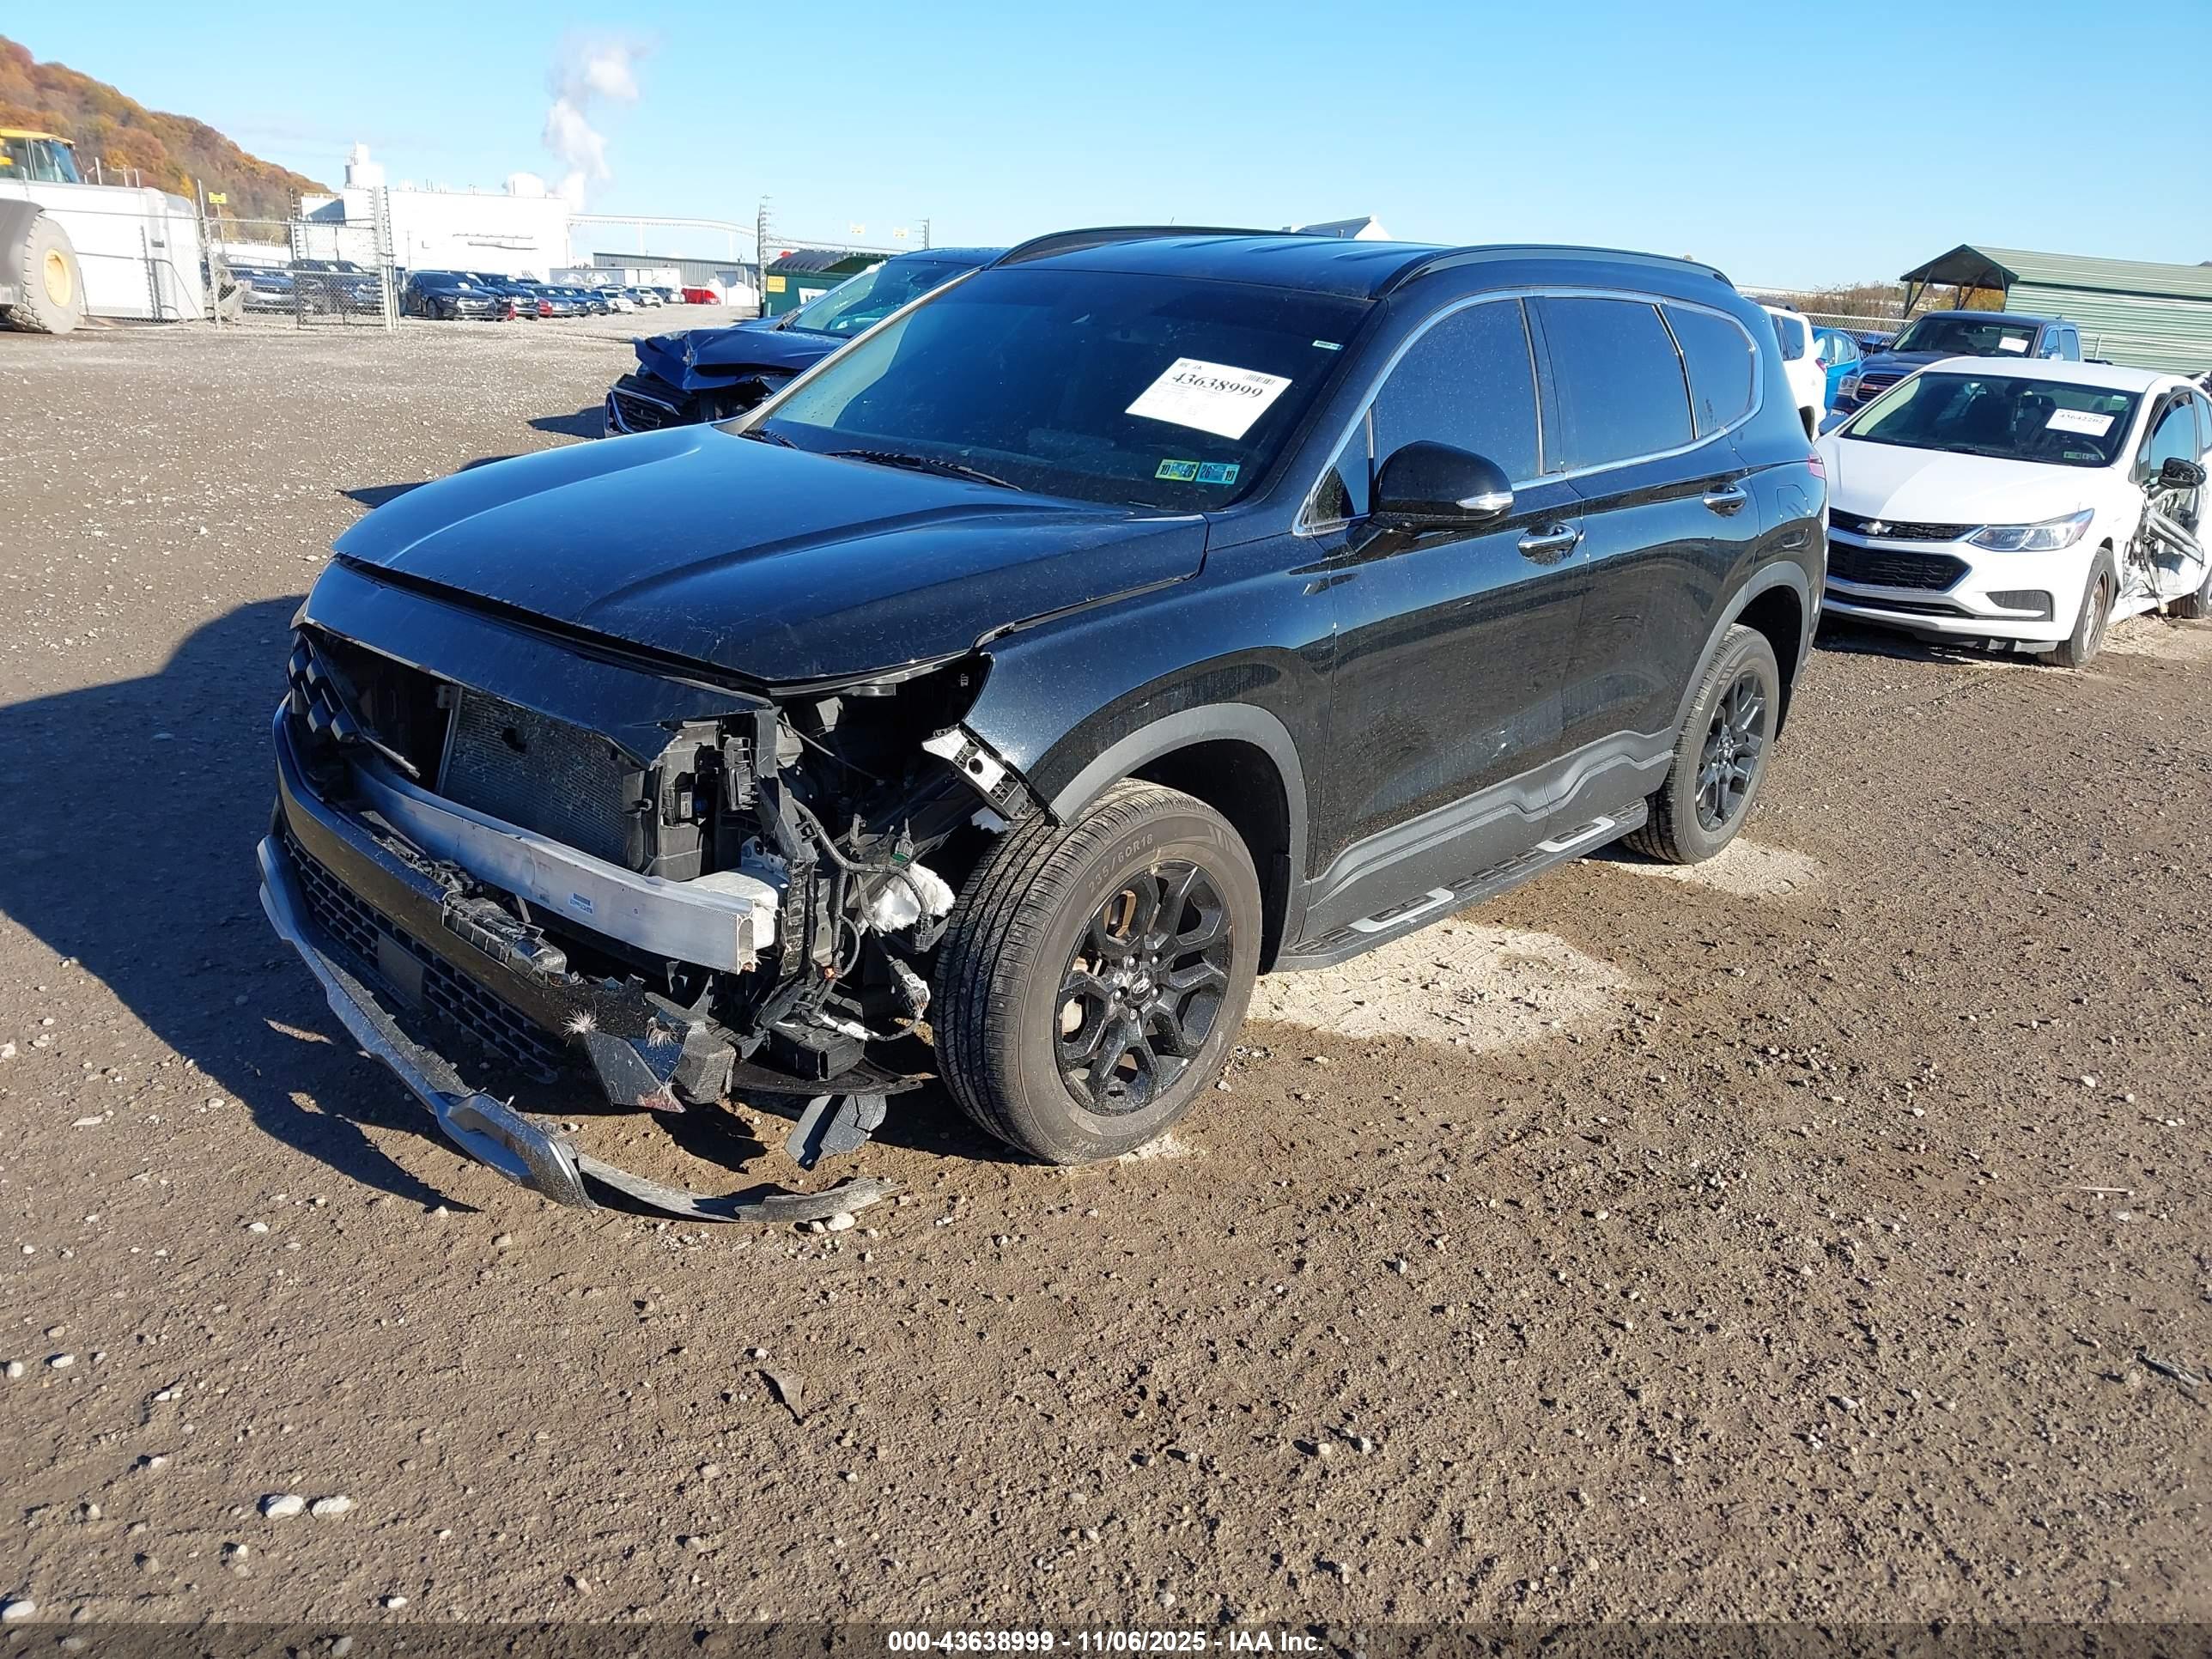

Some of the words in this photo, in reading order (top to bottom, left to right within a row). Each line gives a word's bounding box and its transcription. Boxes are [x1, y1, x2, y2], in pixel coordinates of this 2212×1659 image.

[1171, 372, 1263, 398] 43638999
[1160, 464, 1171, 476] 10
[1182, 464, 1196, 478] 26
[1200, 465, 1212, 479] 26
[1224, 470, 1237, 482] 10
[1088, 833, 1153, 894] 235/60R18
